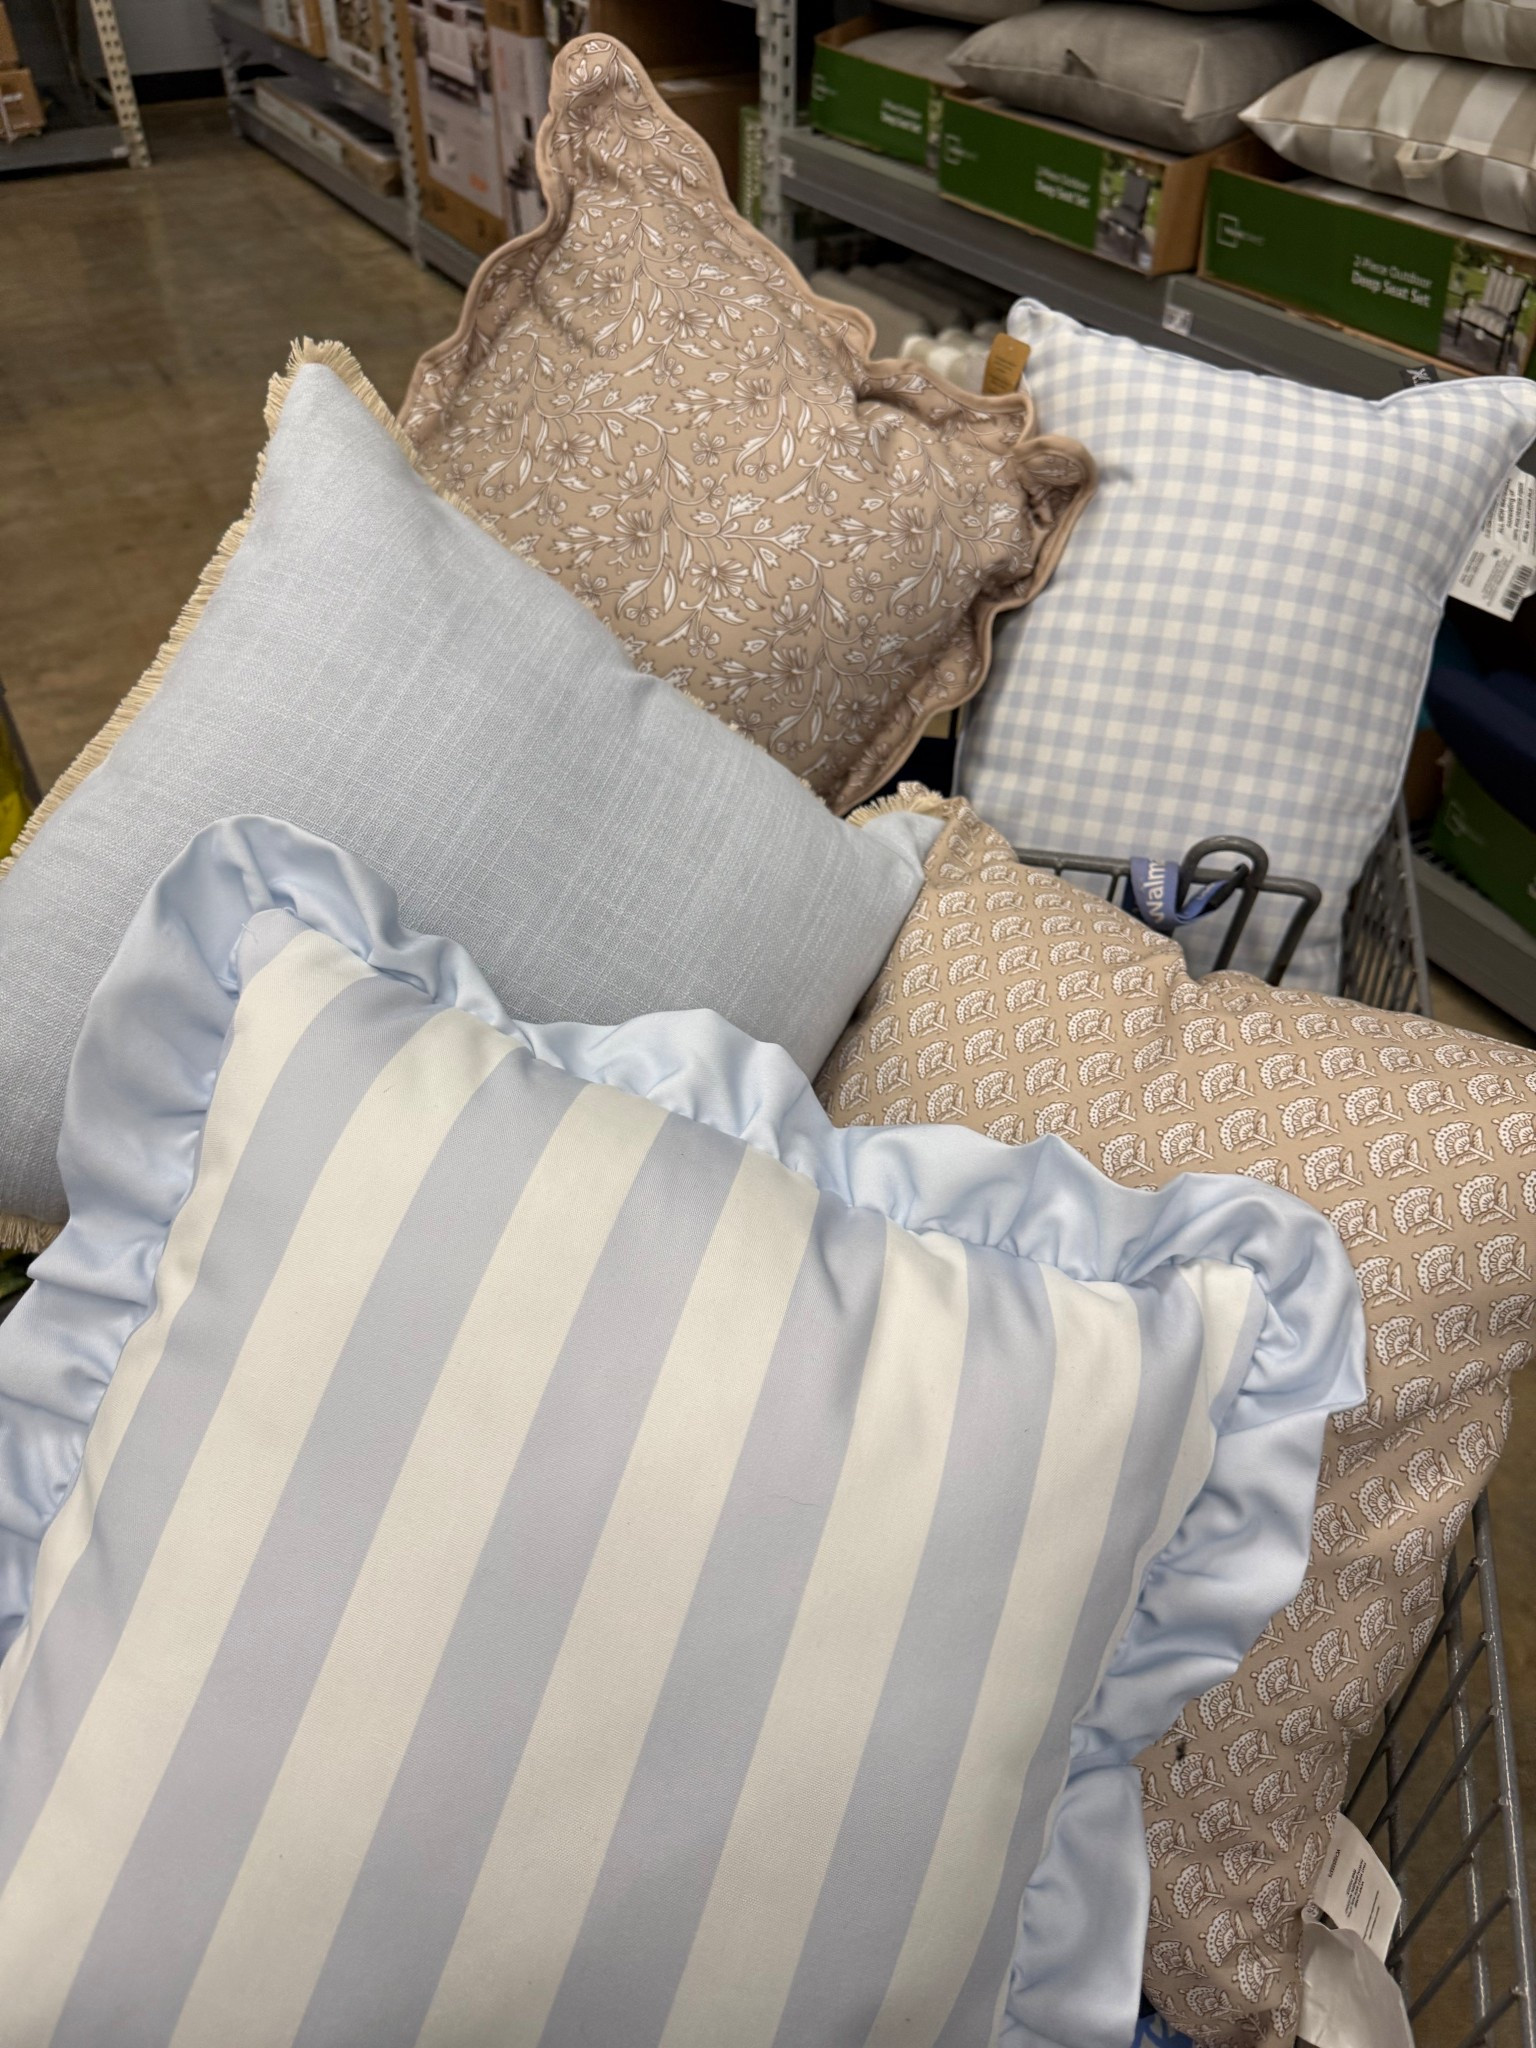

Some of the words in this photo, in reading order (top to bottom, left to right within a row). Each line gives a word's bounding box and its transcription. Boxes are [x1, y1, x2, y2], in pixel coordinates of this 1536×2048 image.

[1351, 269, 1381, 294] Deep
[1410, 288, 1431, 308] Set
[1143, 860, 1166, 923] Walm
